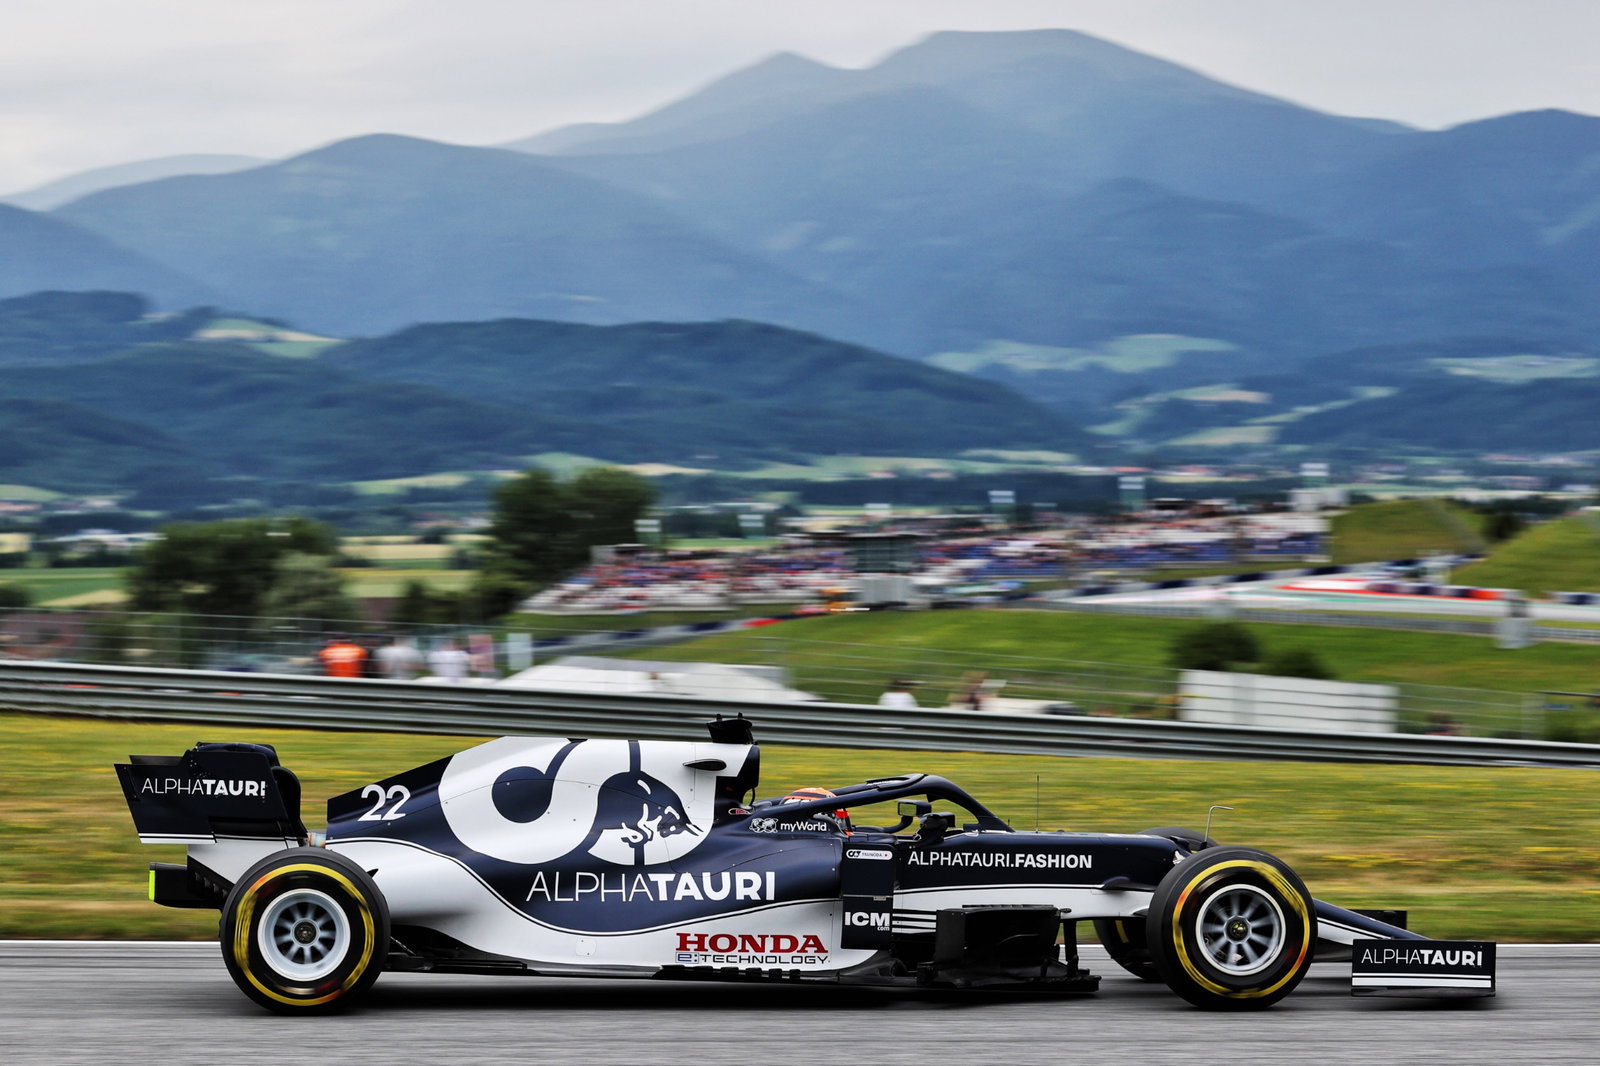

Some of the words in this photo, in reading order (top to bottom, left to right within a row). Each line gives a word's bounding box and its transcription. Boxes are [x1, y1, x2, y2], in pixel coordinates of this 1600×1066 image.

[141, 777, 266, 797] ALPHATAURI
[357, 784, 411, 822] 22
[780, 820, 827, 832] myWorld
[907, 851, 1092, 869] ALPHATAURI.FASHION
[526, 871, 775, 901] ALPHATAURI
[844, 911, 890, 927] ICM
[675, 932, 828, 953] HONDA
[1361, 948, 1482, 966] ALPHATAURI
